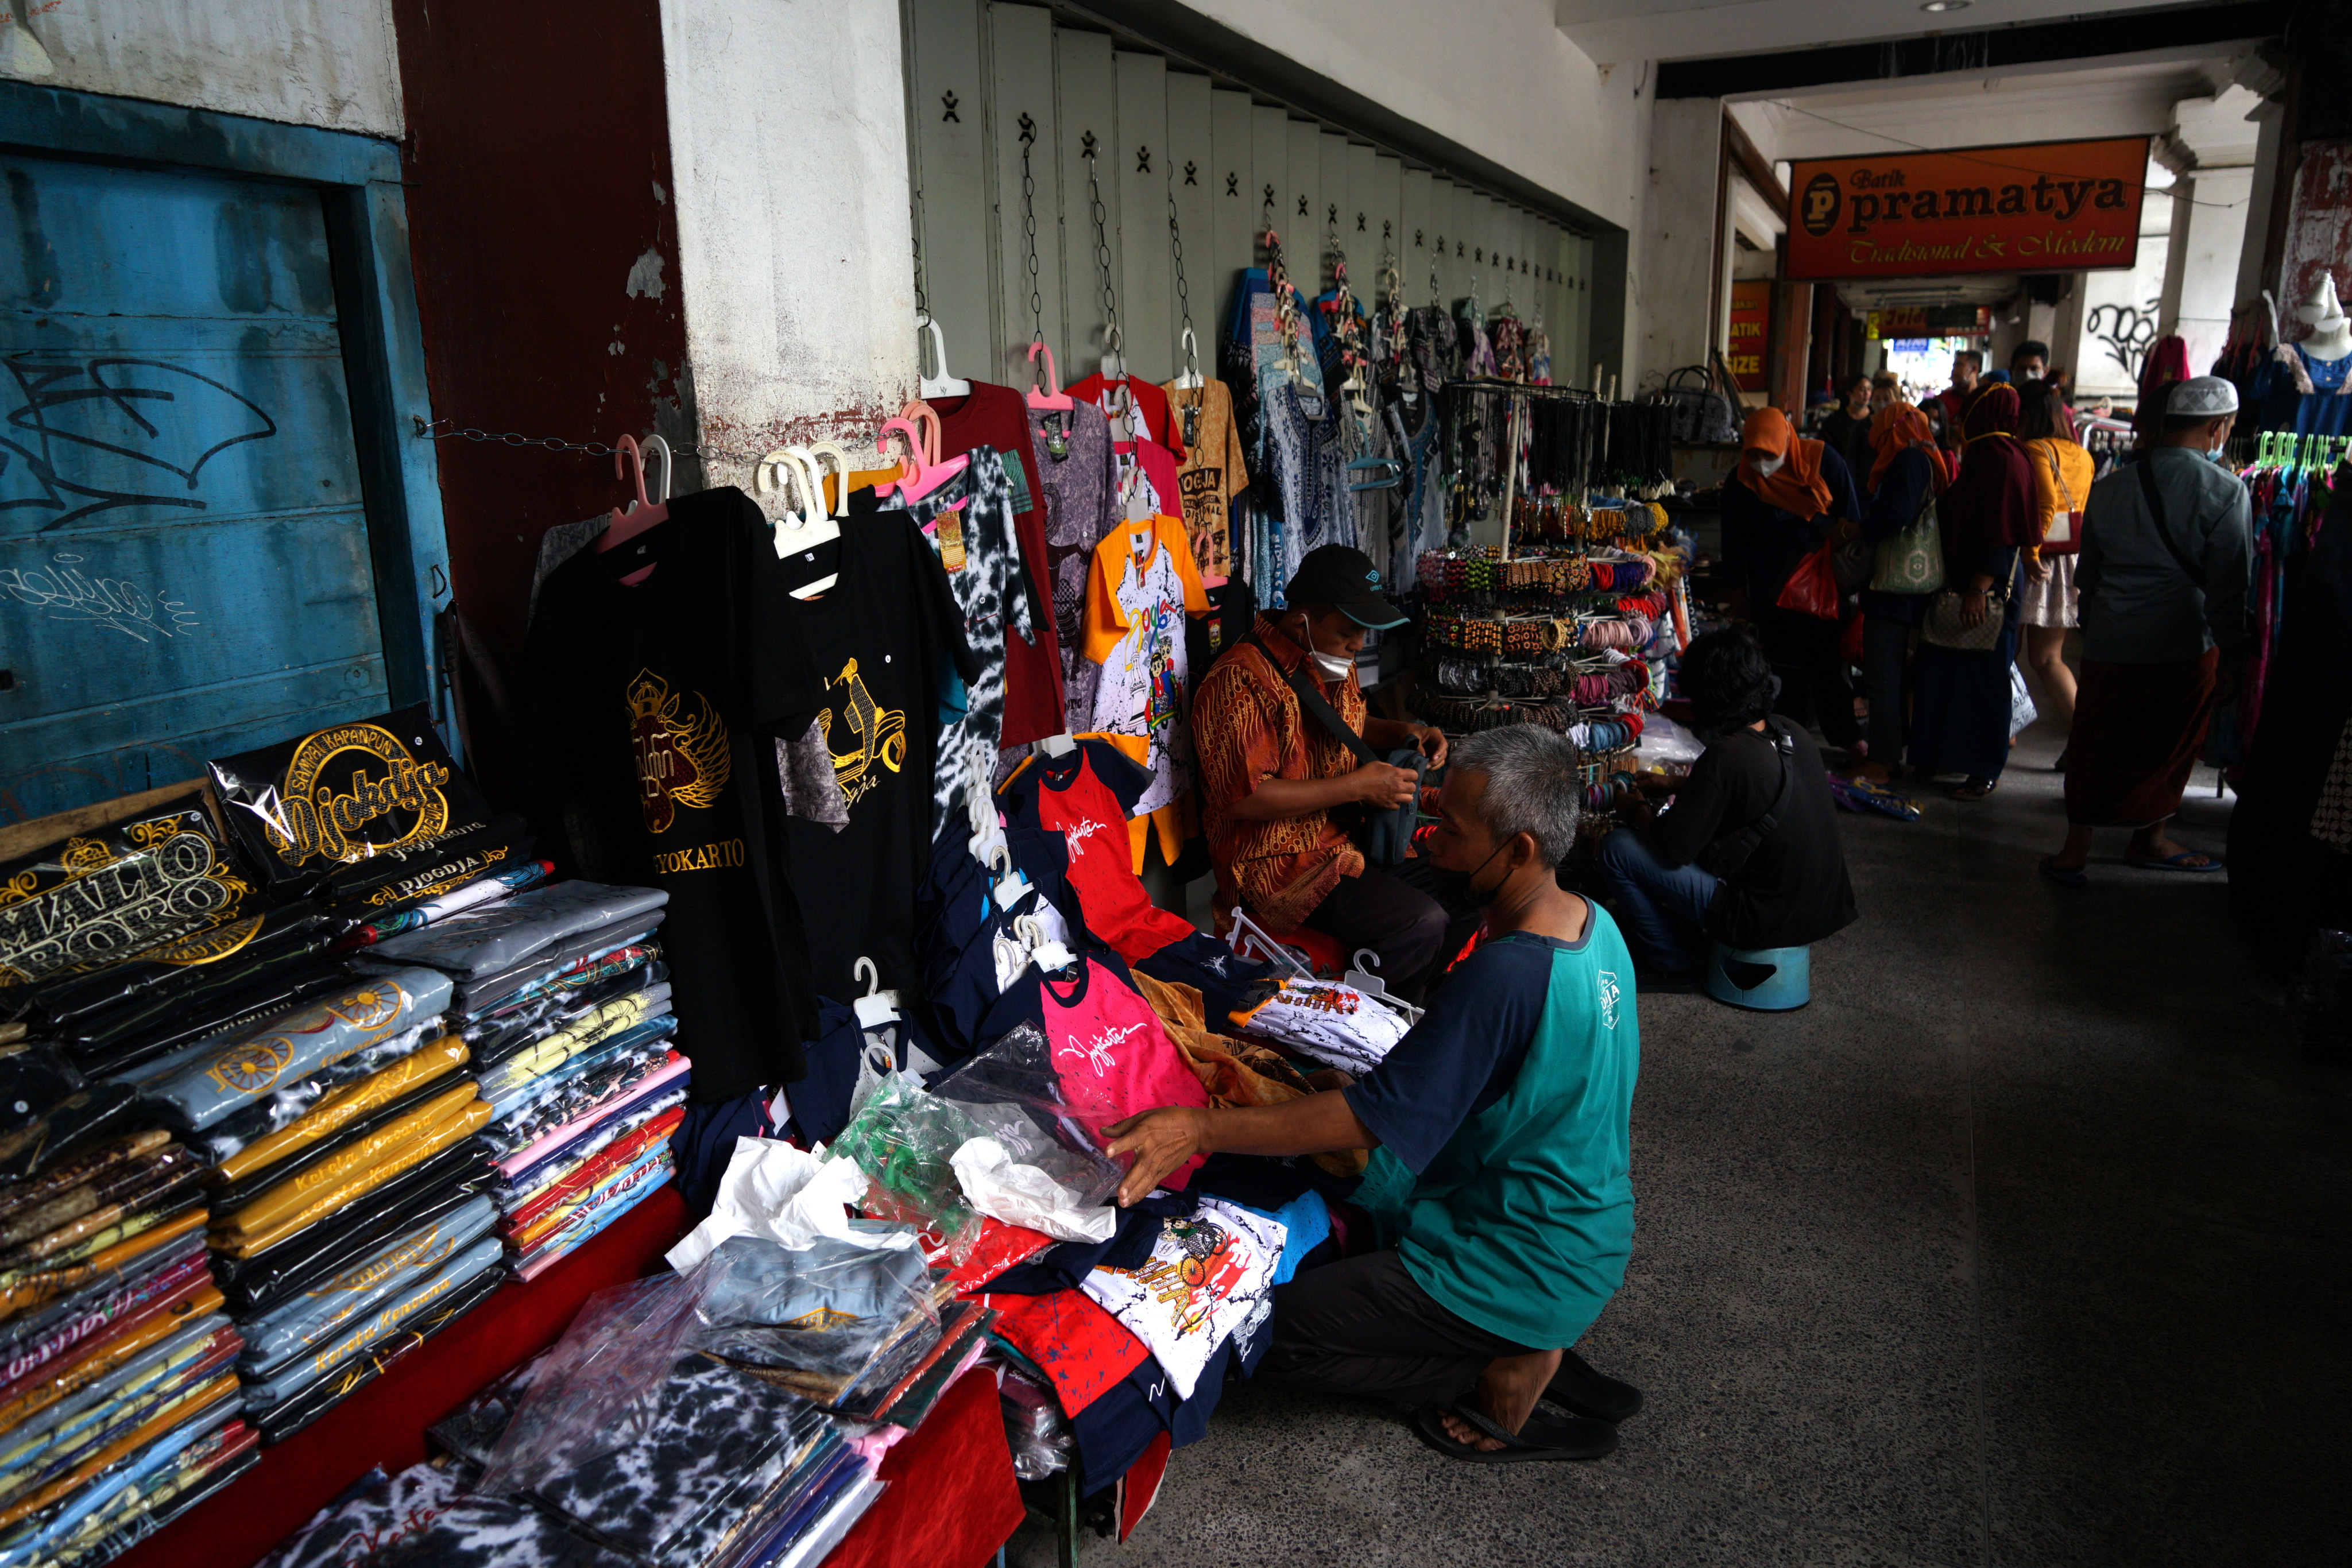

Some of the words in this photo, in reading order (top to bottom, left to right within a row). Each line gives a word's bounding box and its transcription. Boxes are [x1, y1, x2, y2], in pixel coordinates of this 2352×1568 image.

[1850, 169, 1905, 189] Batik
[1847, 174, 2128, 233] pramatya
[1845, 235, 1972, 264] Tradisional
[1975, 235, 2006, 258] &
[2017, 230, 2126, 256] Modern
[1730, 322, 1761, 338] ATIK
[1181, 469, 1216, 493] OGJA
[292, 742, 326, 791] SAMPAI
[322, 729, 393, 756] KAPANPUN
[653, 837, 745, 875] YOKARTO
[1134, 1263, 1159, 1276] Kraton
[1153, 1275, 1180, 1290] Borobudur
[316, 1326, 377, 1374] Kereta
[380, 1277, 452, 1330] Kencana
